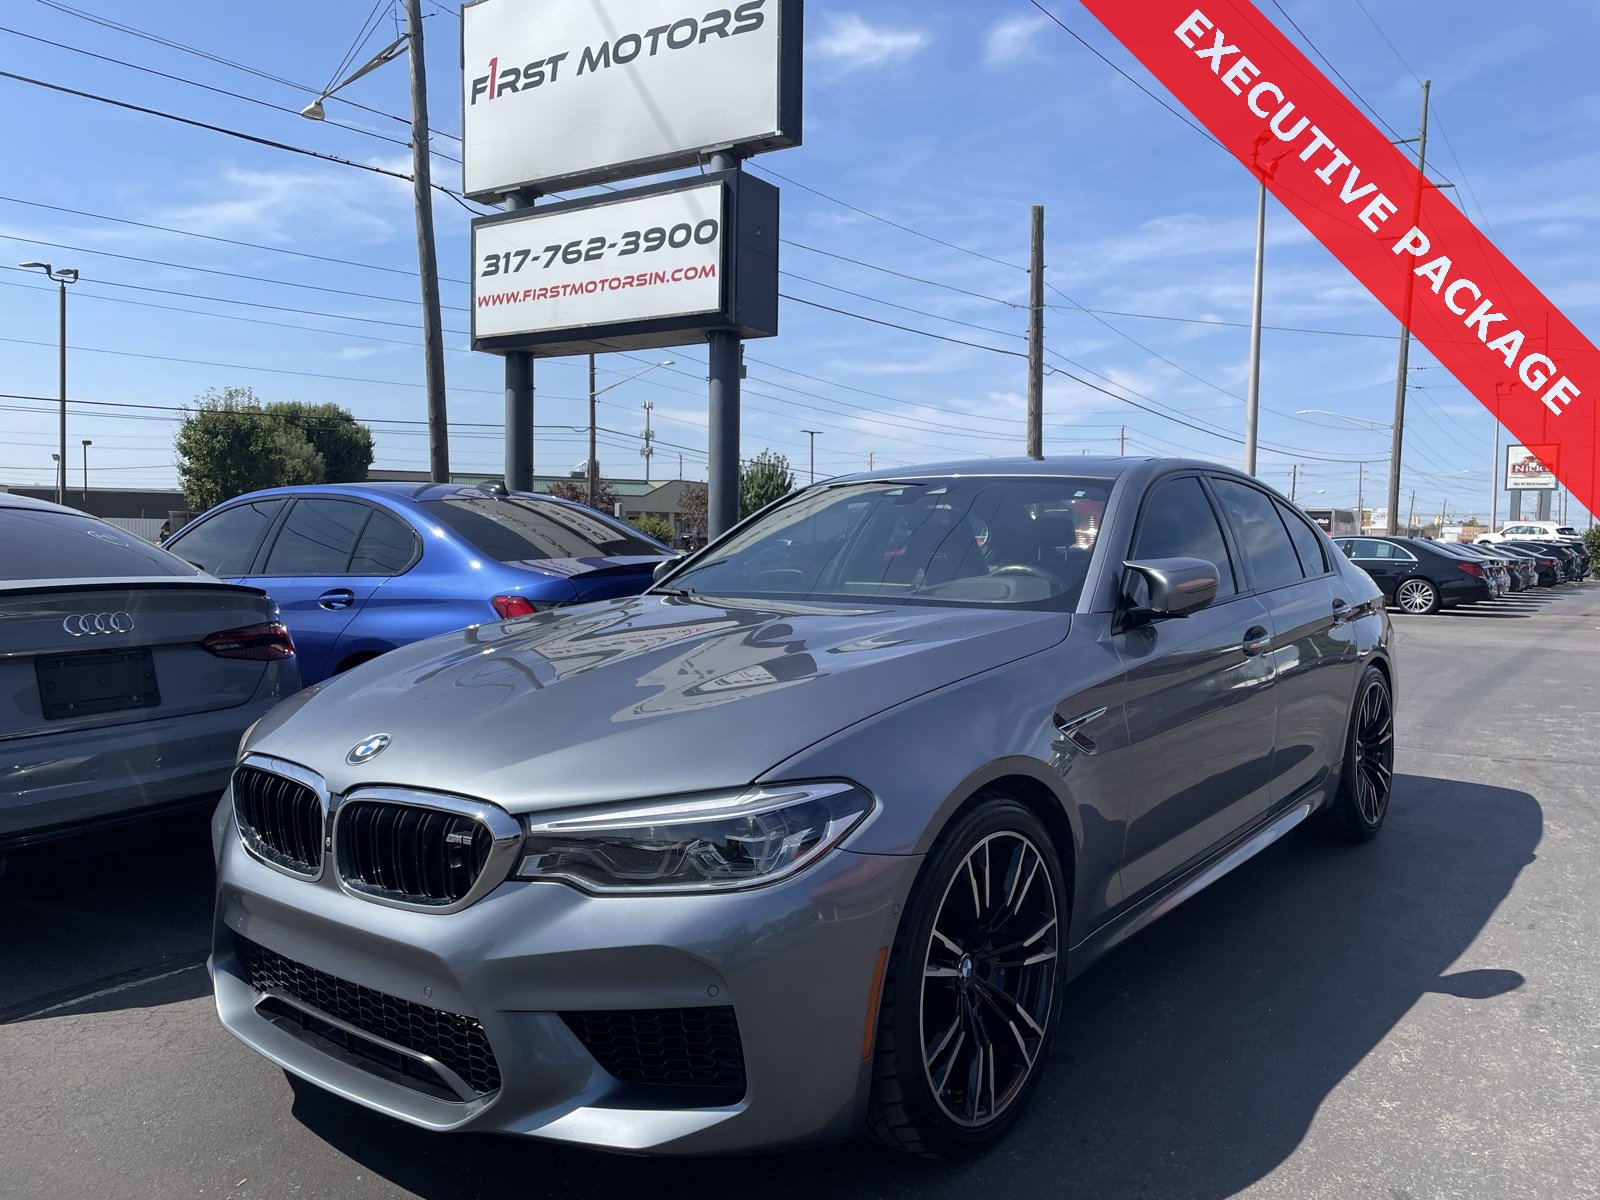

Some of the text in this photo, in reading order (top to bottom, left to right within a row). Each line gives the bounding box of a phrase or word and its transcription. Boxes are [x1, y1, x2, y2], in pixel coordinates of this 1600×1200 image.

[576, 0, 766, 76] MOTORS
[480, 218, 719, 278] 317-762-3900
[477, 263, 716, 309] WWW.FIRSTMOTORSIN.COM
